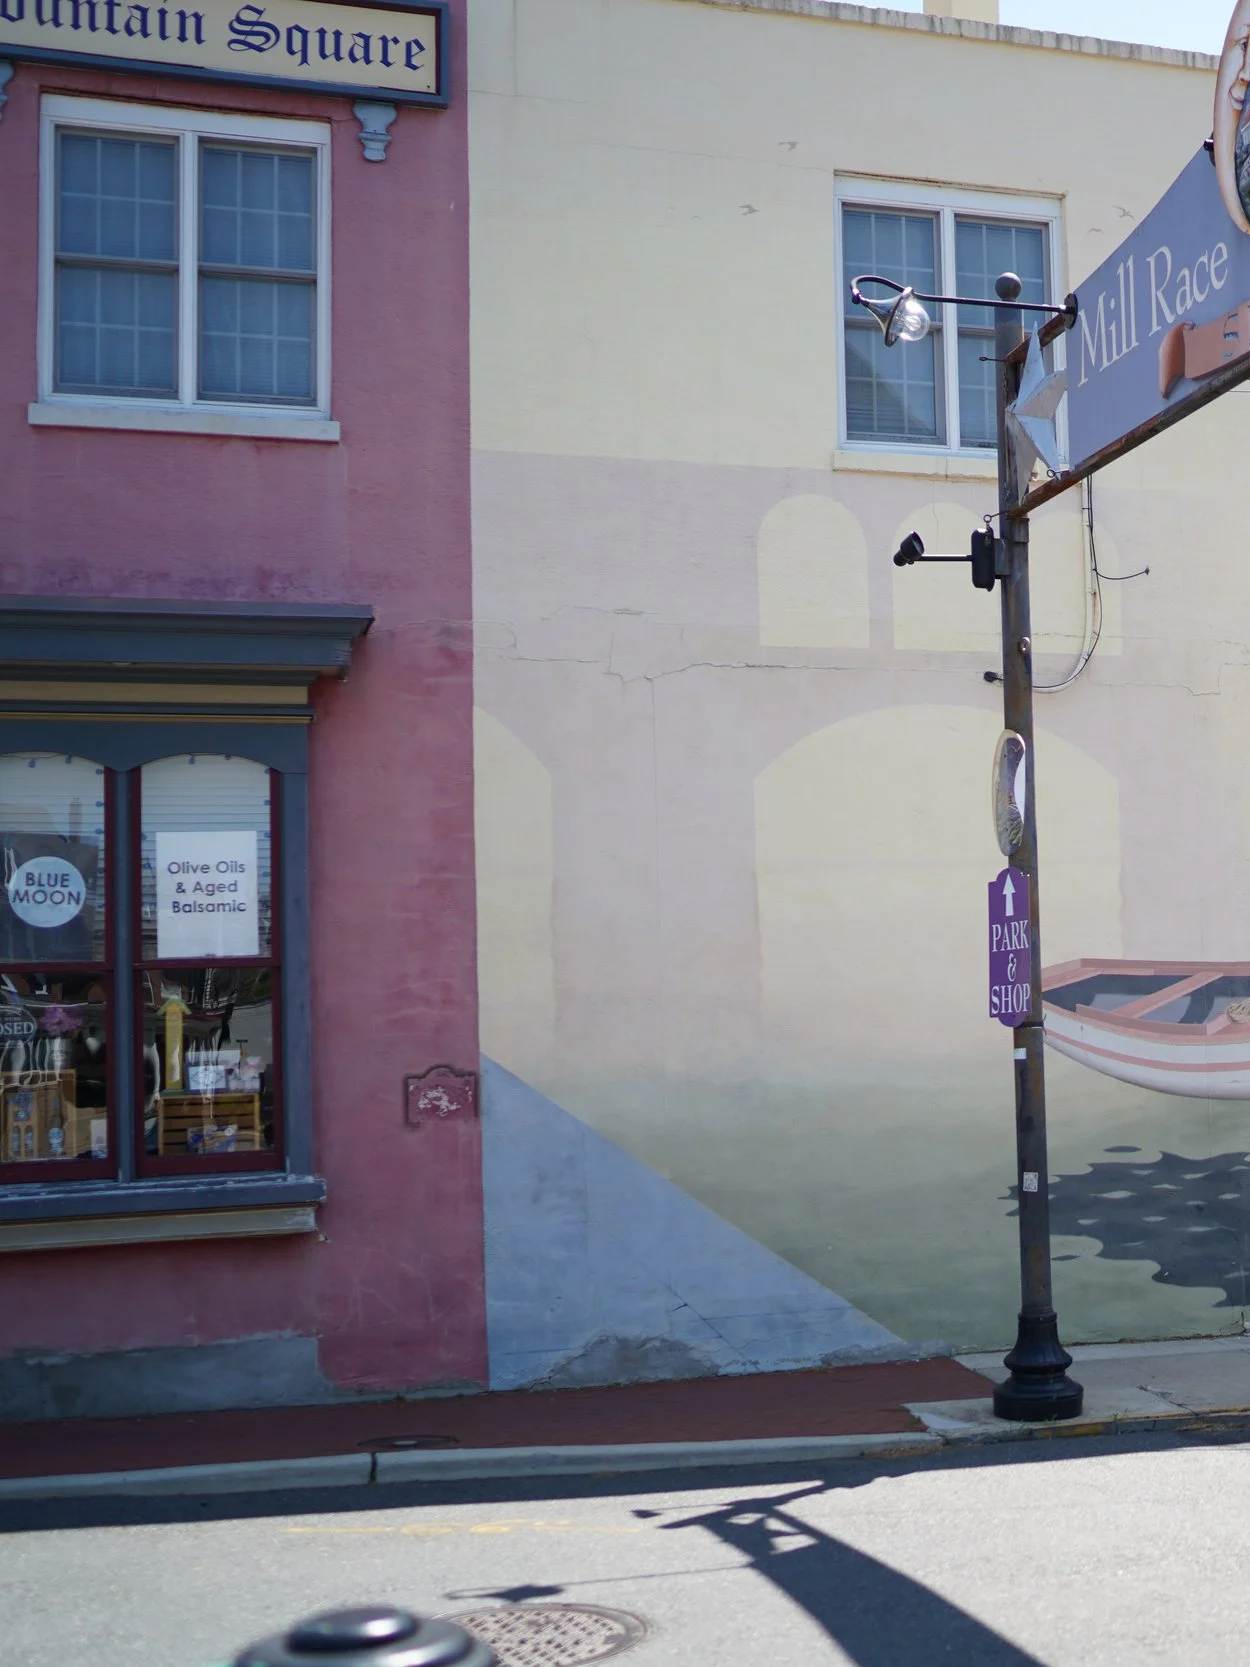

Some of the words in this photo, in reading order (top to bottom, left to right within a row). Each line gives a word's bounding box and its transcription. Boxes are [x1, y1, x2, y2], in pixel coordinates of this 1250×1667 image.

[228, 4, 426, 71] Square
[1077, 254, 1140, 388] Mill
[1146, 241, 1229, 337] Race
[167, 861, 210, 875] Olive
[216, 860, 246, 874] Oils
[25, 871, 70, 888] BLUE
[175, 881, 186, 894] &
[192, 880, 238, 896] Aged
[12, 888, 80, 905] MOON
[172, 899, 247, 914] Balsamic
[991, 919, 1029, 953] PARK
[1007, 952, 1017, 982] &
[991, 983, 1031, 1015] SHOP
